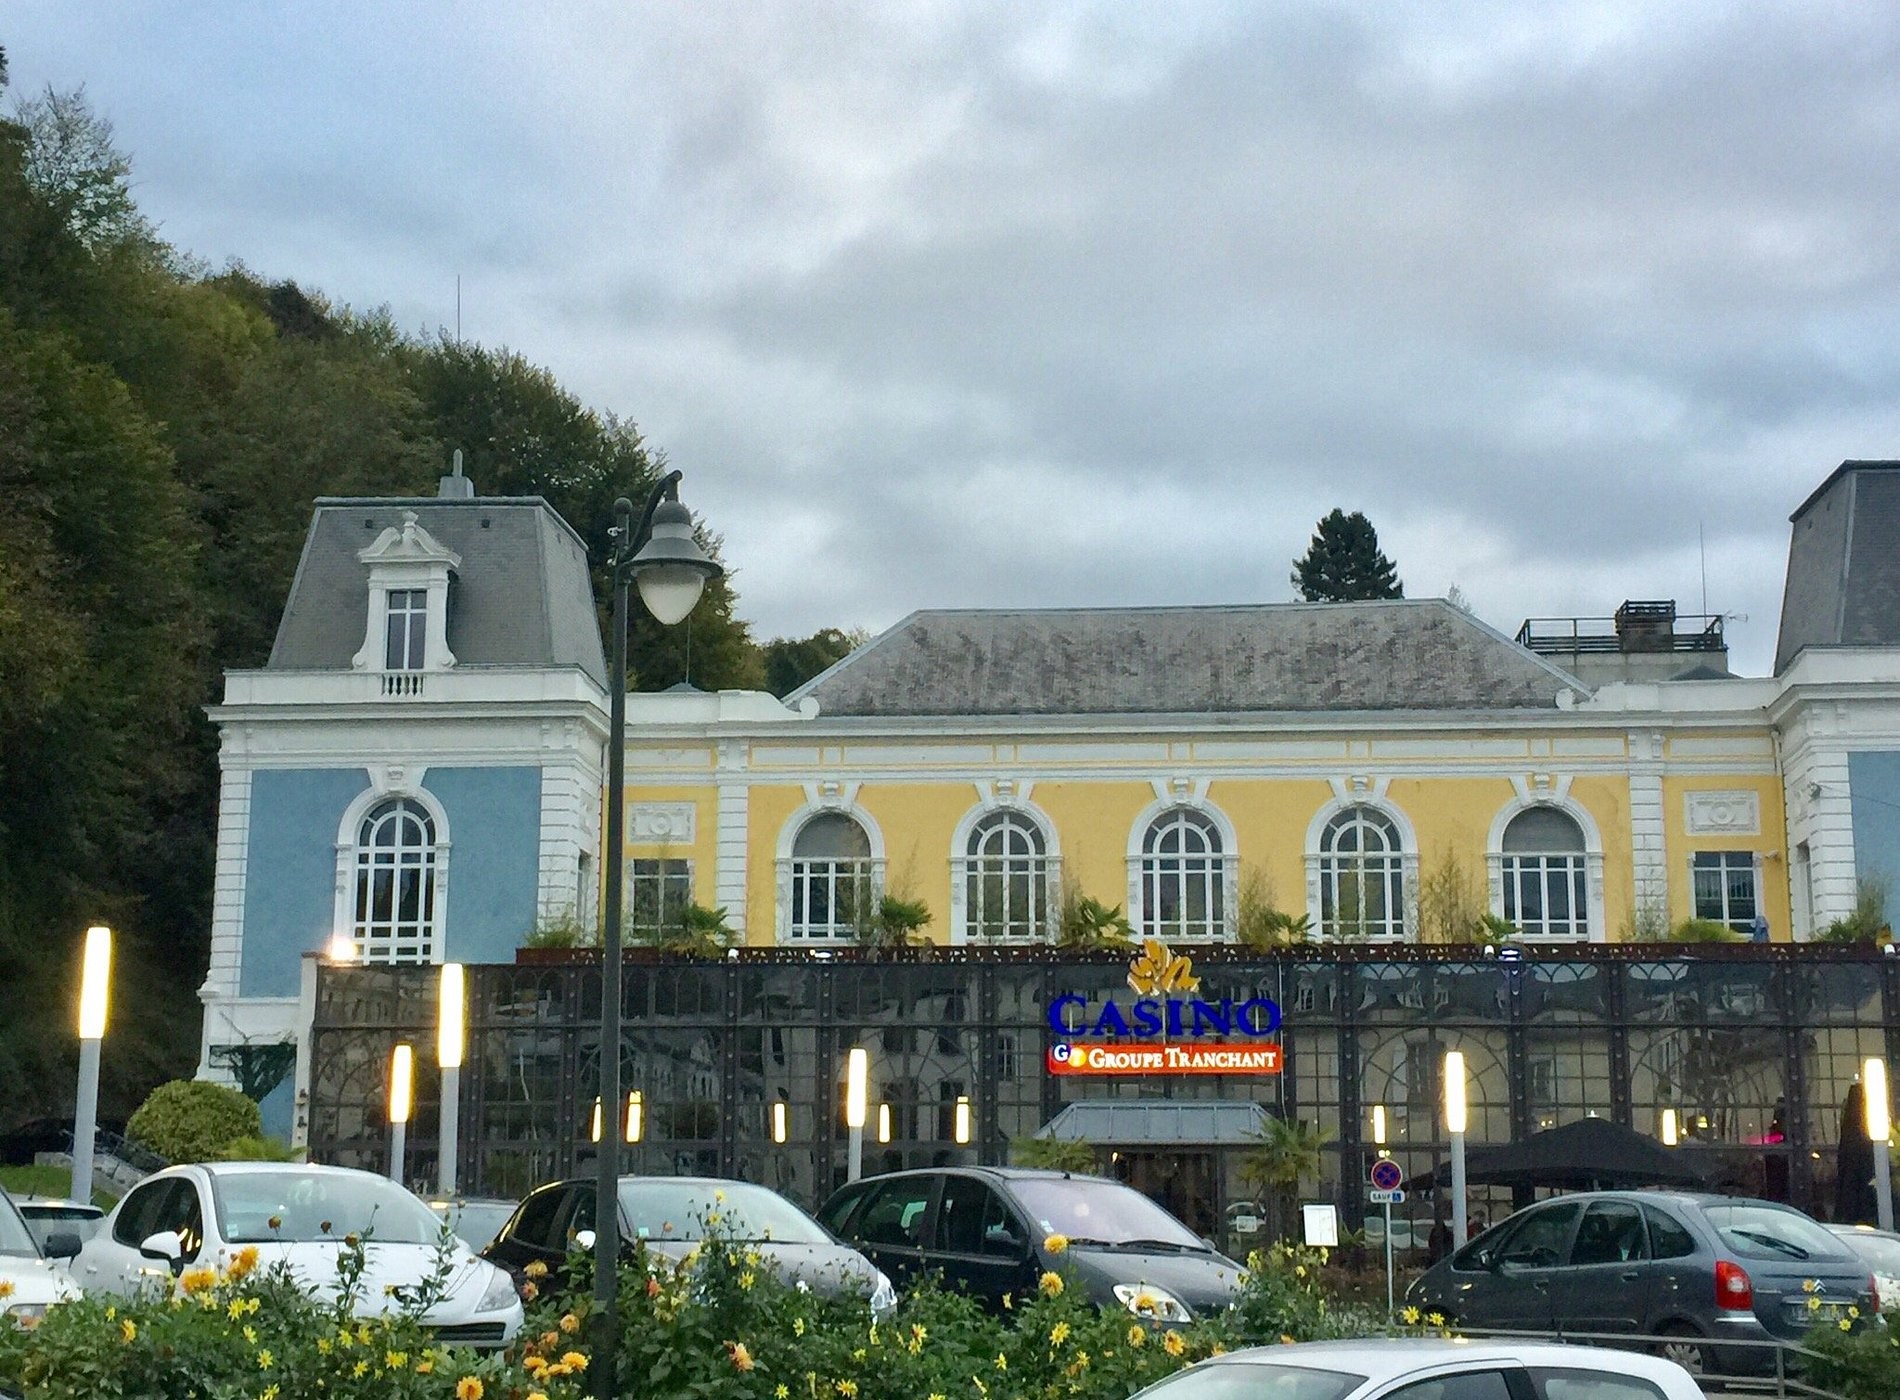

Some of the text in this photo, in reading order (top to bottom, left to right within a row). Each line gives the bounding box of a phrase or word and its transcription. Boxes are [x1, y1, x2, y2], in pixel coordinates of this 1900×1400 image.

[1048, 995, 1282, 1036] CASINO
[1088, 1048, 1163, 1068] GROUPE
[1165, 1047, 1276, 1067] TRANCHANT
